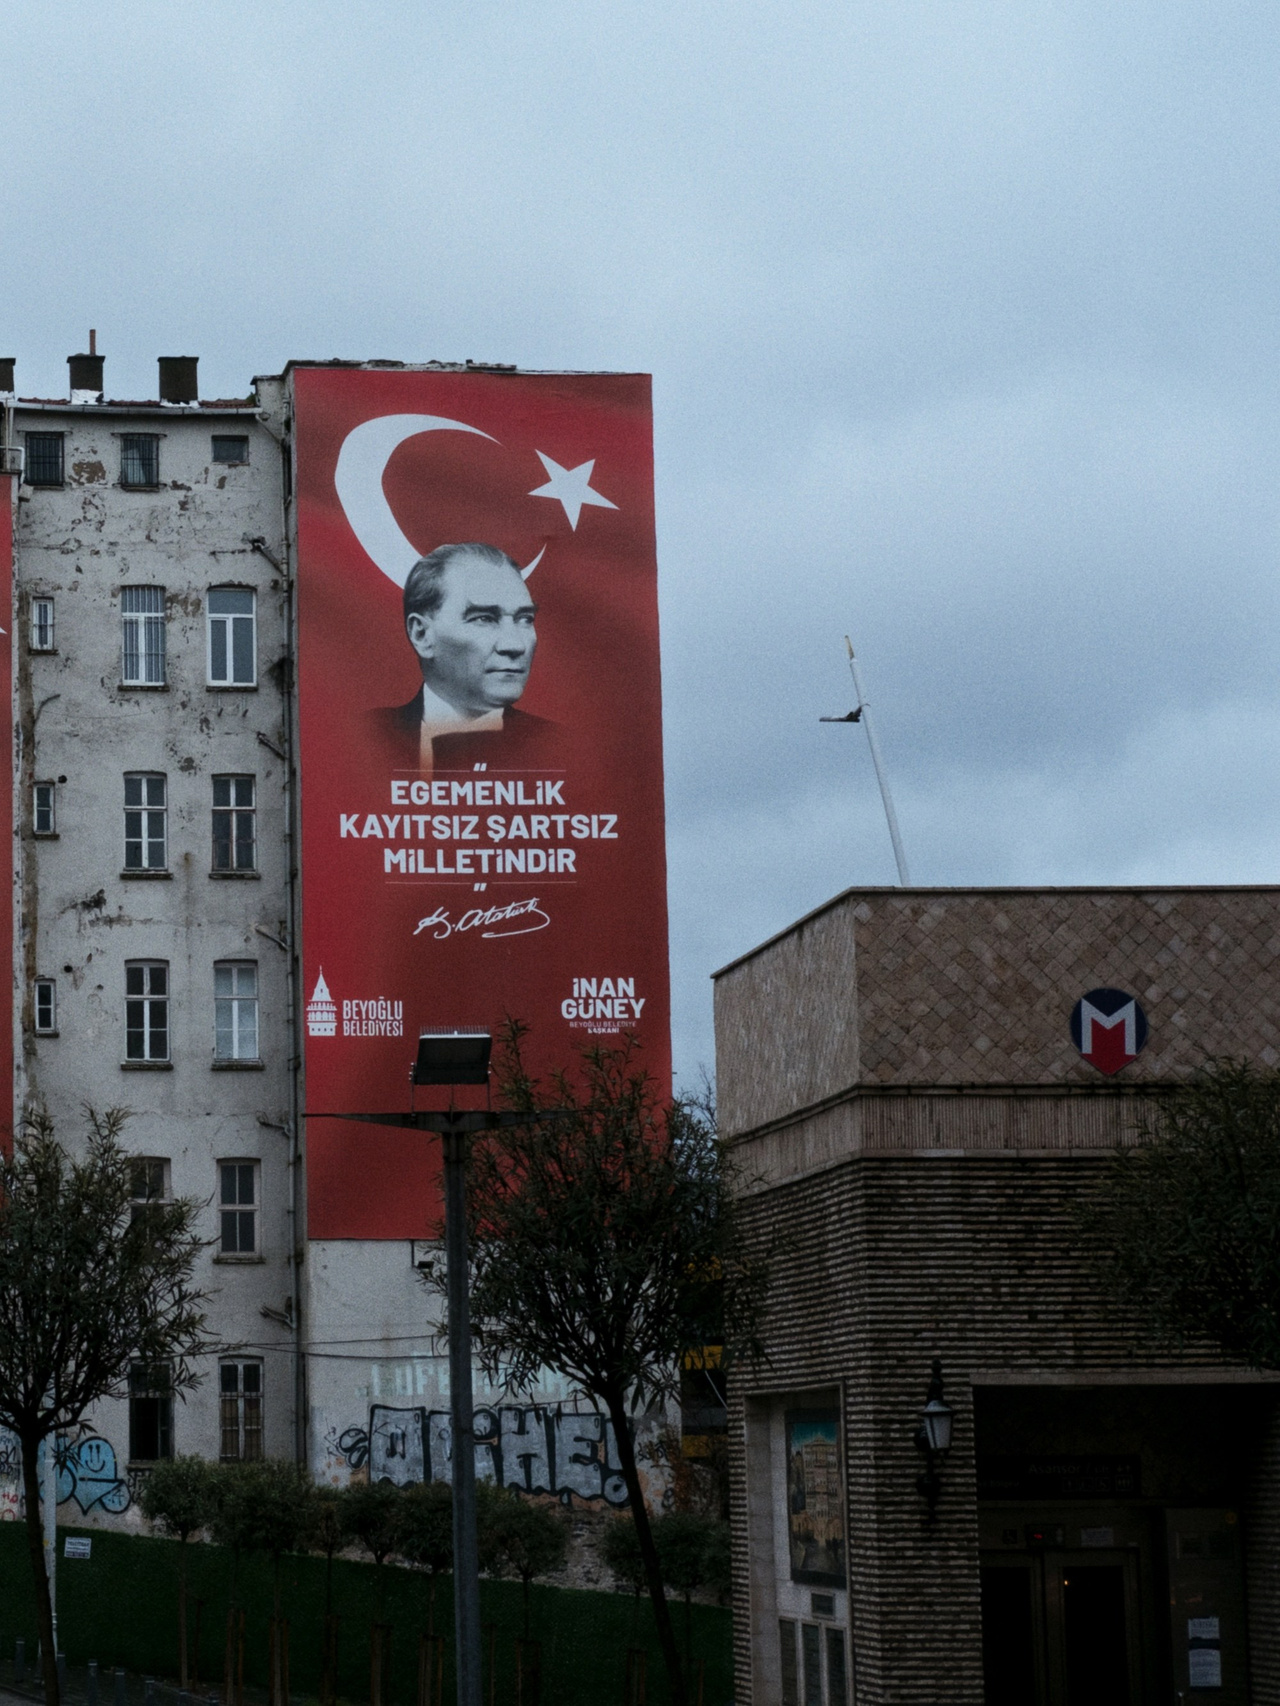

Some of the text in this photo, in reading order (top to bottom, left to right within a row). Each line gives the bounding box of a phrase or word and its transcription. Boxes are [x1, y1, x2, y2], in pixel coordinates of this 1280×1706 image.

[390, 780, 566, 806] EGEMENLİK
[339, 813, 619, 843] KAYITSIZ ŞARTSIZ
[383, 848, 577, 874] MİLLETİNDİR
[572, 977, 635, 998] İNAN
[342, 995, 403, 1020] BEYOĞLU
[561, 998, 646, 1020] GÜNEY
[342, 1020, 404, 1037] BELEDİYESİ
